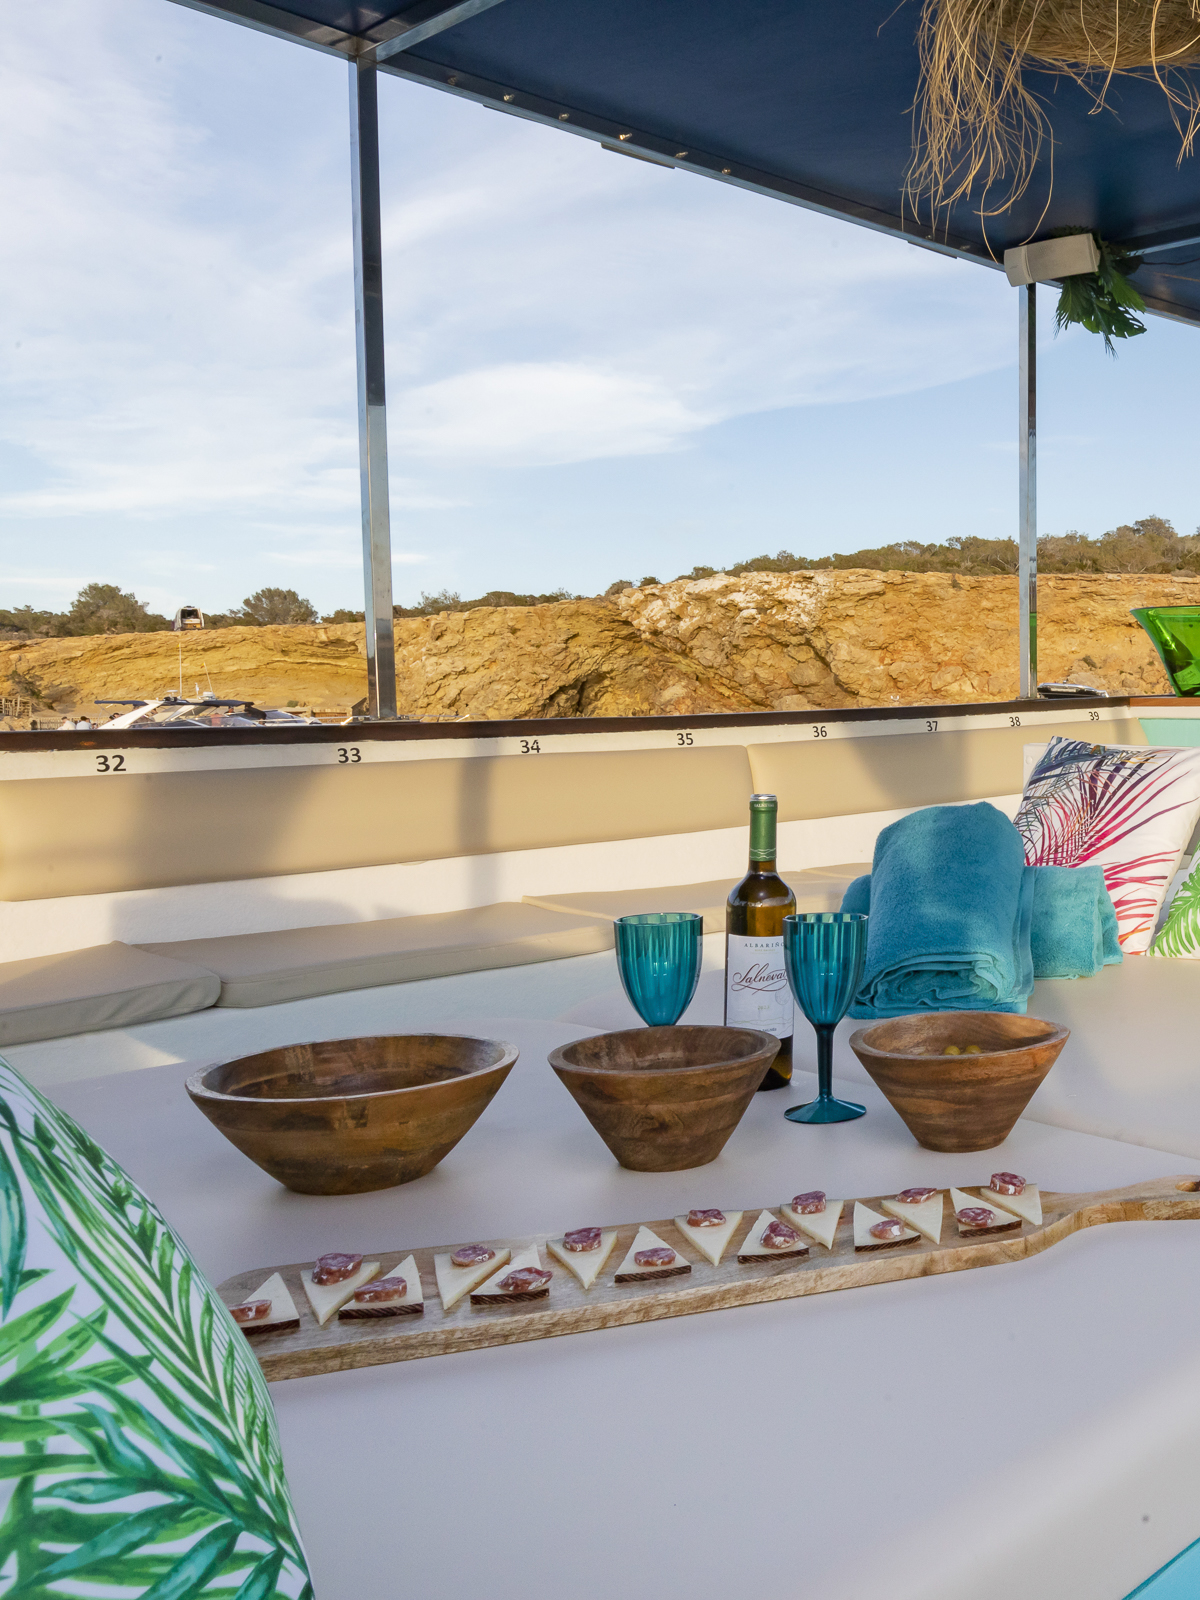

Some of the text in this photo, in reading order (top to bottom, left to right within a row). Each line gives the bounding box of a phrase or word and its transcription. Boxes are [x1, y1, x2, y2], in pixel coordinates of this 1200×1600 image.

[1009, 716, 1021, 727] 38
[1088, 711, 1100, 721] 39
[812, 725, 827, 738] 36
[926, 720, 938, 732] 37
[676, 733, 694, 746] 35
[519, 739, 541, 754] 34
[337, 747, 362, 764] 33
[95, 754, 127, 773] 32
